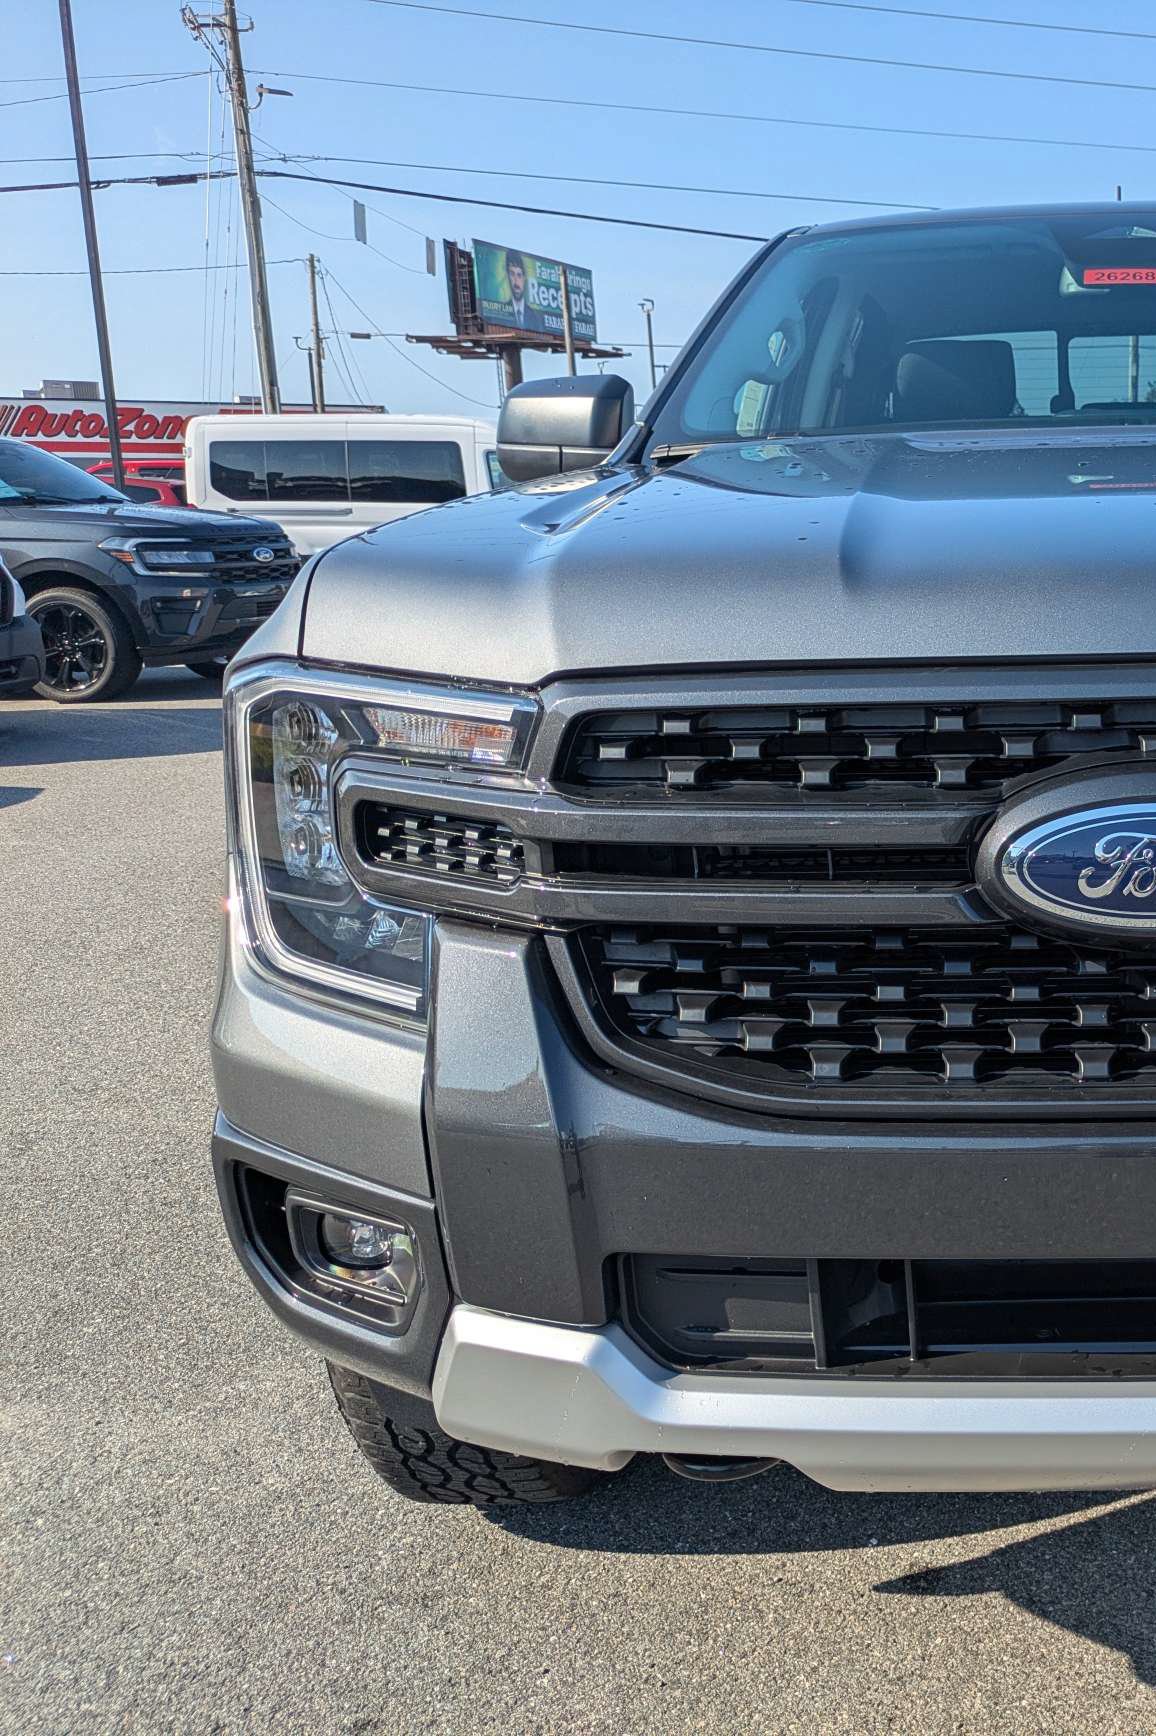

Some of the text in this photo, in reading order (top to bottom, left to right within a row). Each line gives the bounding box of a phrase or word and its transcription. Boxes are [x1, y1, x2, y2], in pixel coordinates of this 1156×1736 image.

[567, 268, 592, 292] rings
[1095, 272, 1156, 281] 26268
[528, 278, 594, 318] Recepts
